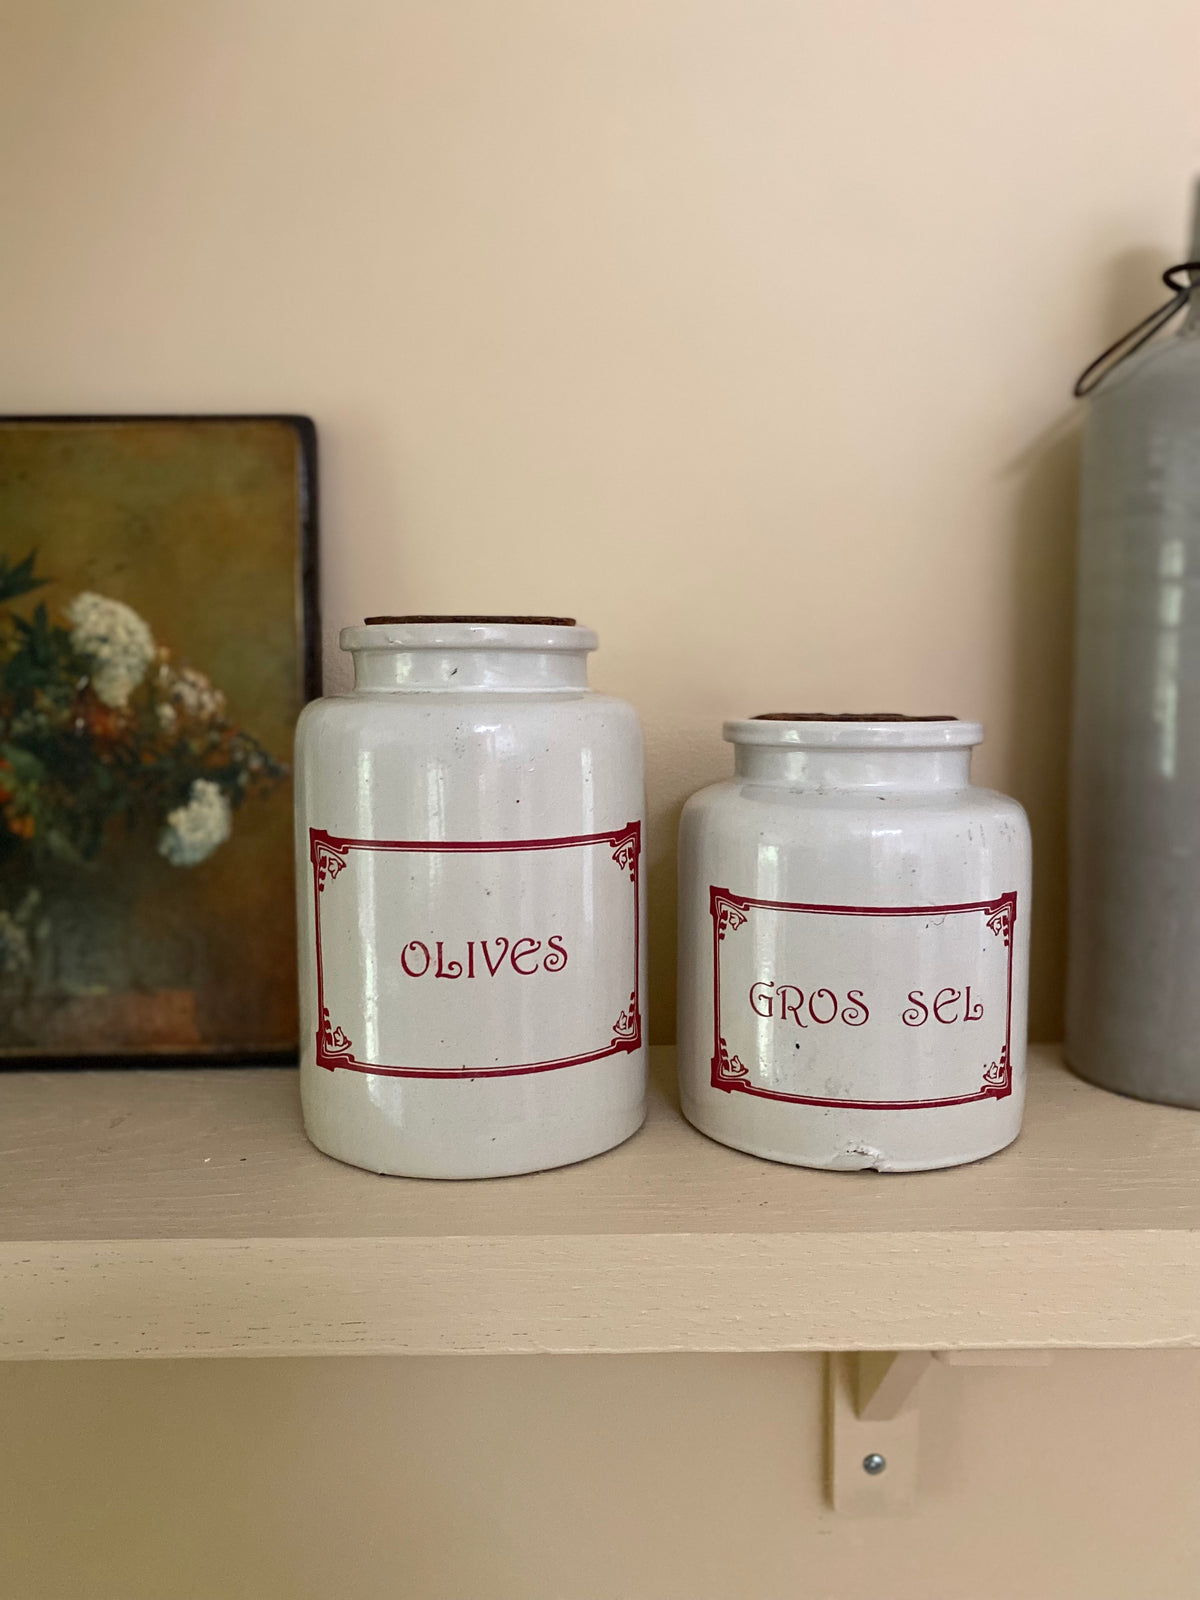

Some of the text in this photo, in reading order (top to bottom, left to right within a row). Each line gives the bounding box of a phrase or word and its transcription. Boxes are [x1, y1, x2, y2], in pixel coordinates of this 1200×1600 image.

[400, 935, 568, 979] OLIVES
[749, 981, 984, 1028] GROS SEL
